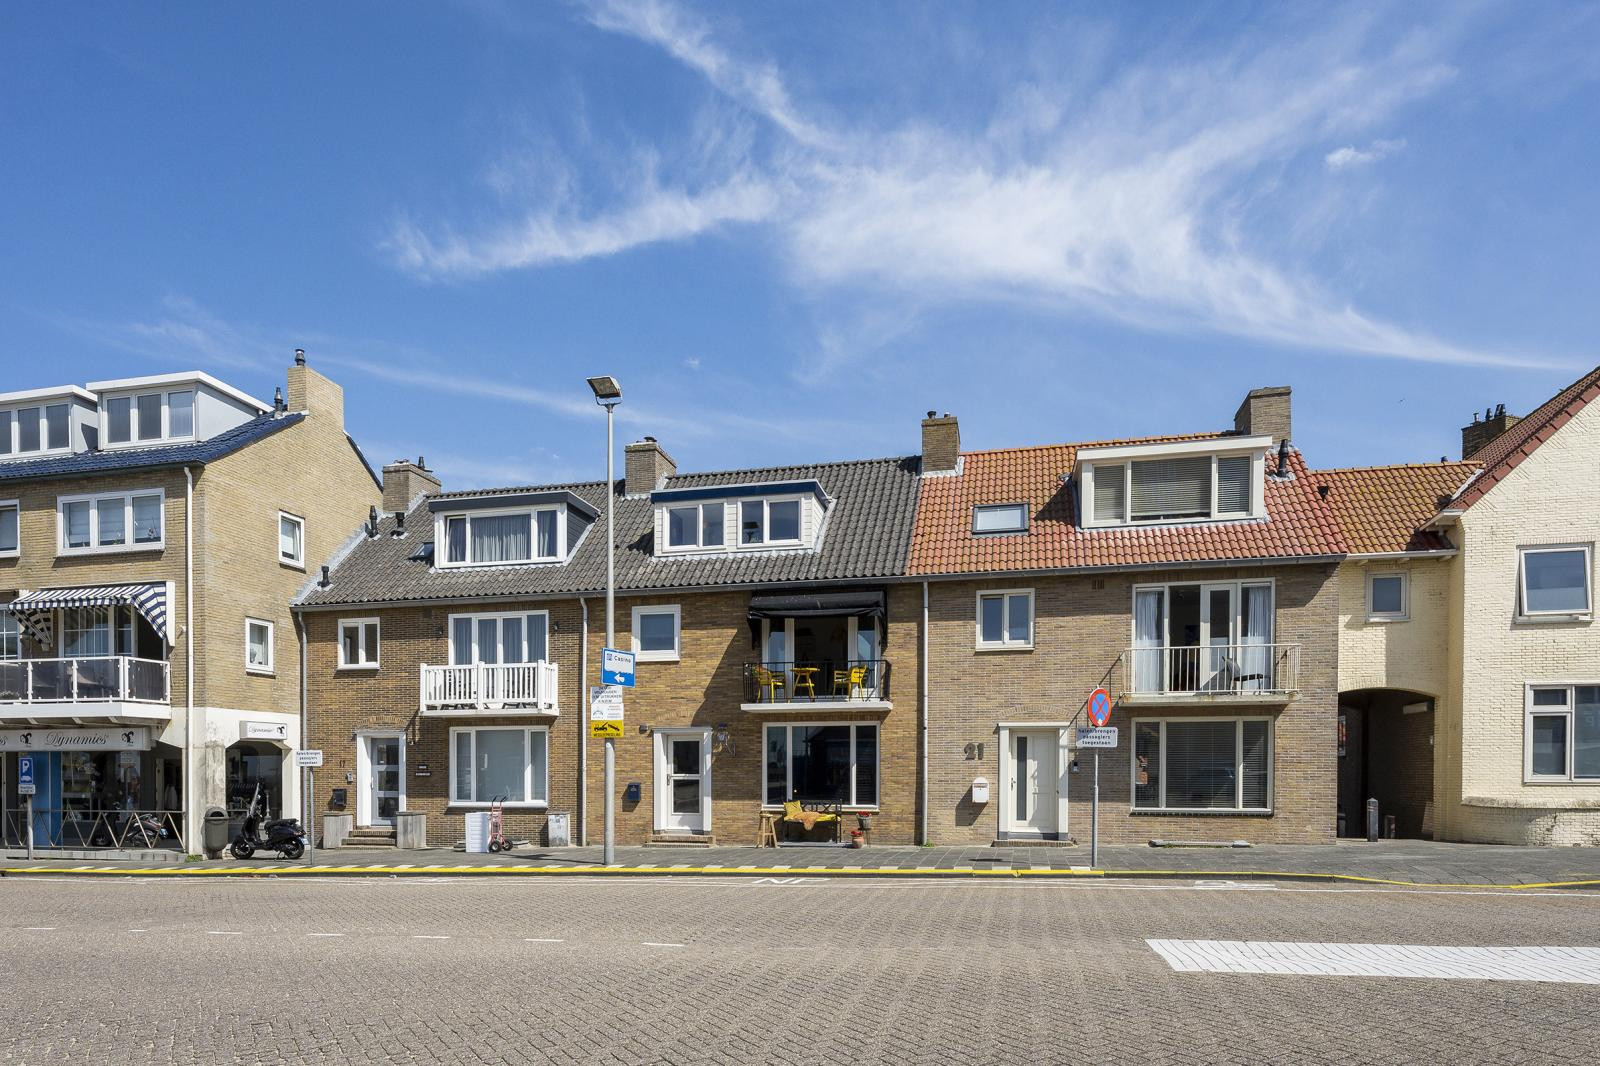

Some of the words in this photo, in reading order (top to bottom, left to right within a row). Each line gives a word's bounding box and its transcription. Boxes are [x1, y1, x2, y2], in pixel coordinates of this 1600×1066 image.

[614, 655, 631, 664] Casino
[45, 731, 109, 747] Dynamics
[964, 742, 984, 760] 21
[22, 760, 30, 773] P
